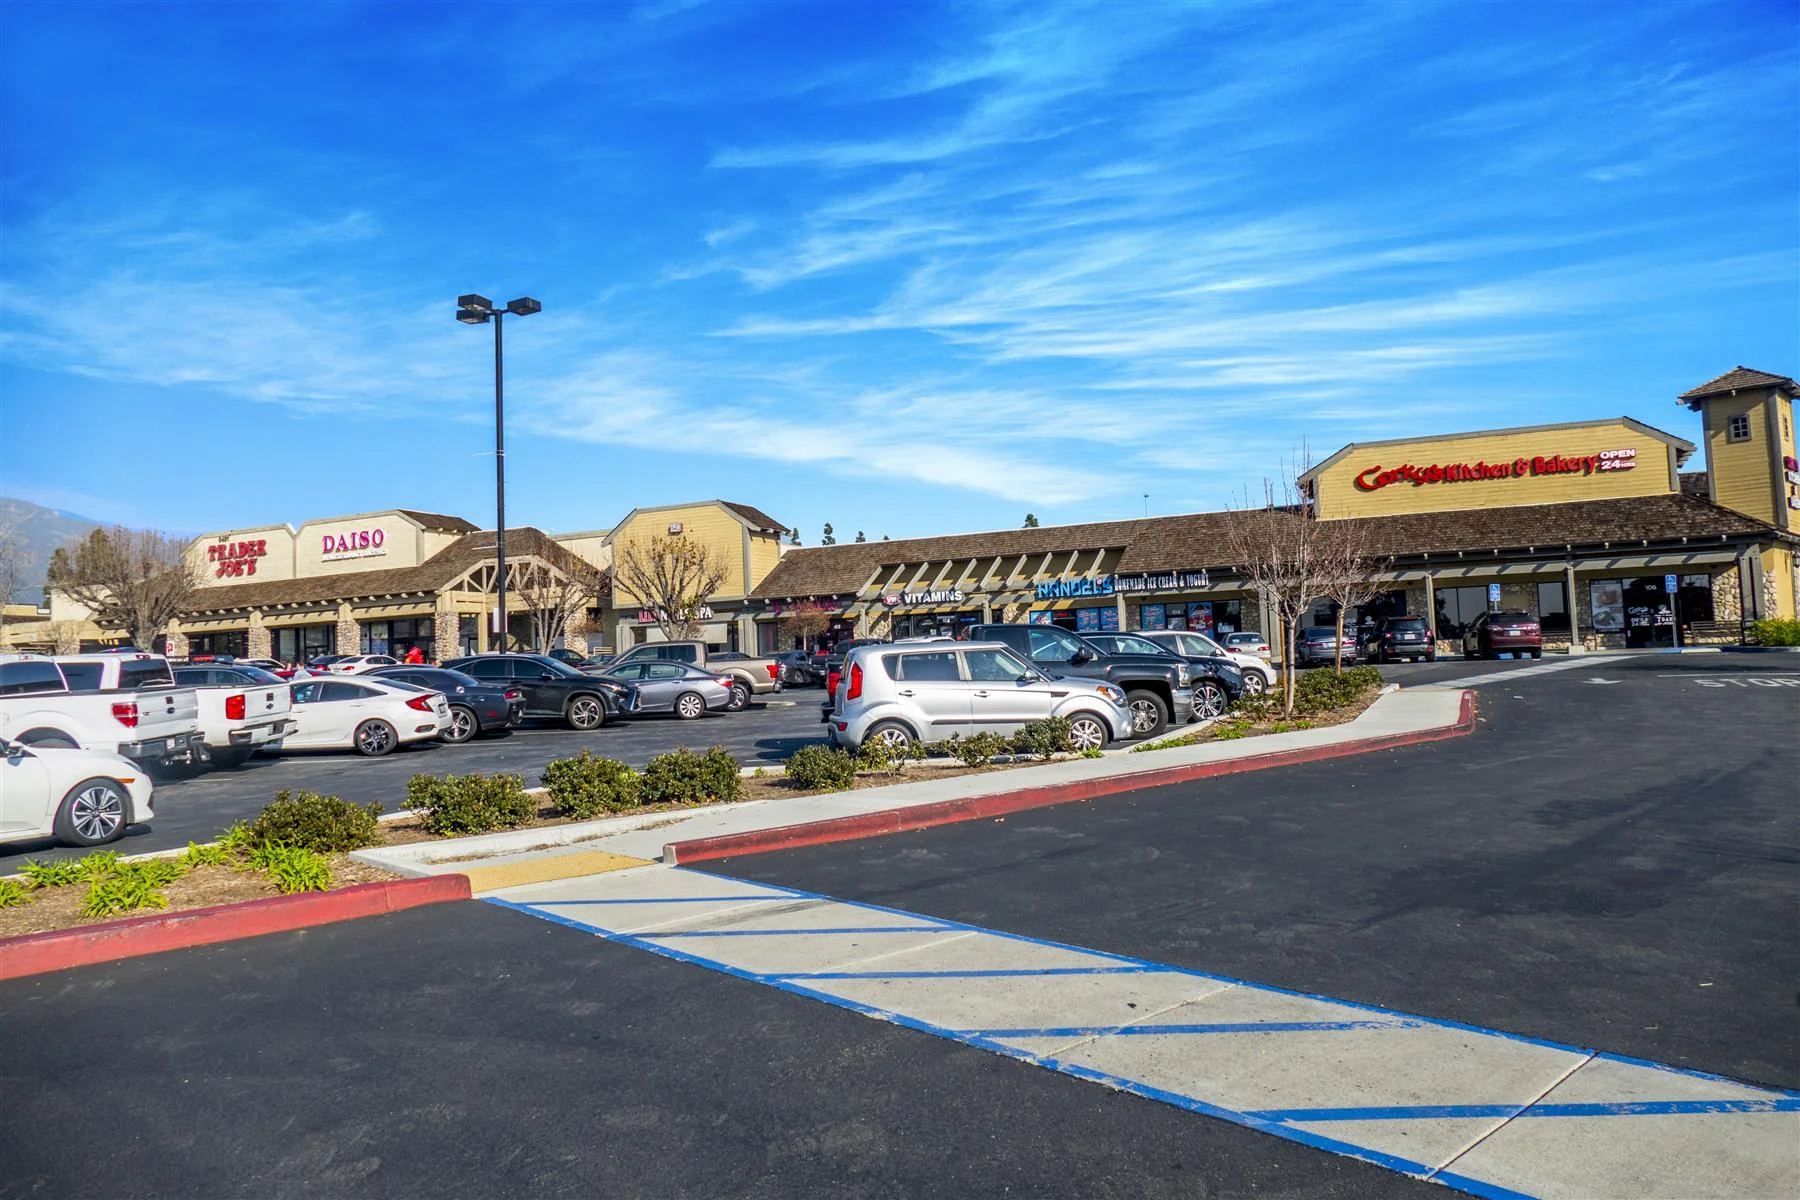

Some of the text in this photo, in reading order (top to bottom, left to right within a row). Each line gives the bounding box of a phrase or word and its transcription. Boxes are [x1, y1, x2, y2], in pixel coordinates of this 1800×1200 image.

[1600, 449, 1636, 459] OPEN
[1446, 461, 1512, 480] Kitchen
[1515, 457, 1531, 475] &
[1533, 454, 1599, 475] Bakery
[323, 529, 384, 554] DAISO
[208, 540, 267, 562] TRADER
[215, 558, 257, 578] JOE'S
[1114, 577, 1146, 591] HOMEMADE
[1147, 577, 1157, 589] ICE
[1158, 575, 1178, 588] CREAM
[1186, 574, 1209, 587] YOGURT
[904, 590, 963, 604] VITAMINS
[1694, 678, 1800, 687] STOP
